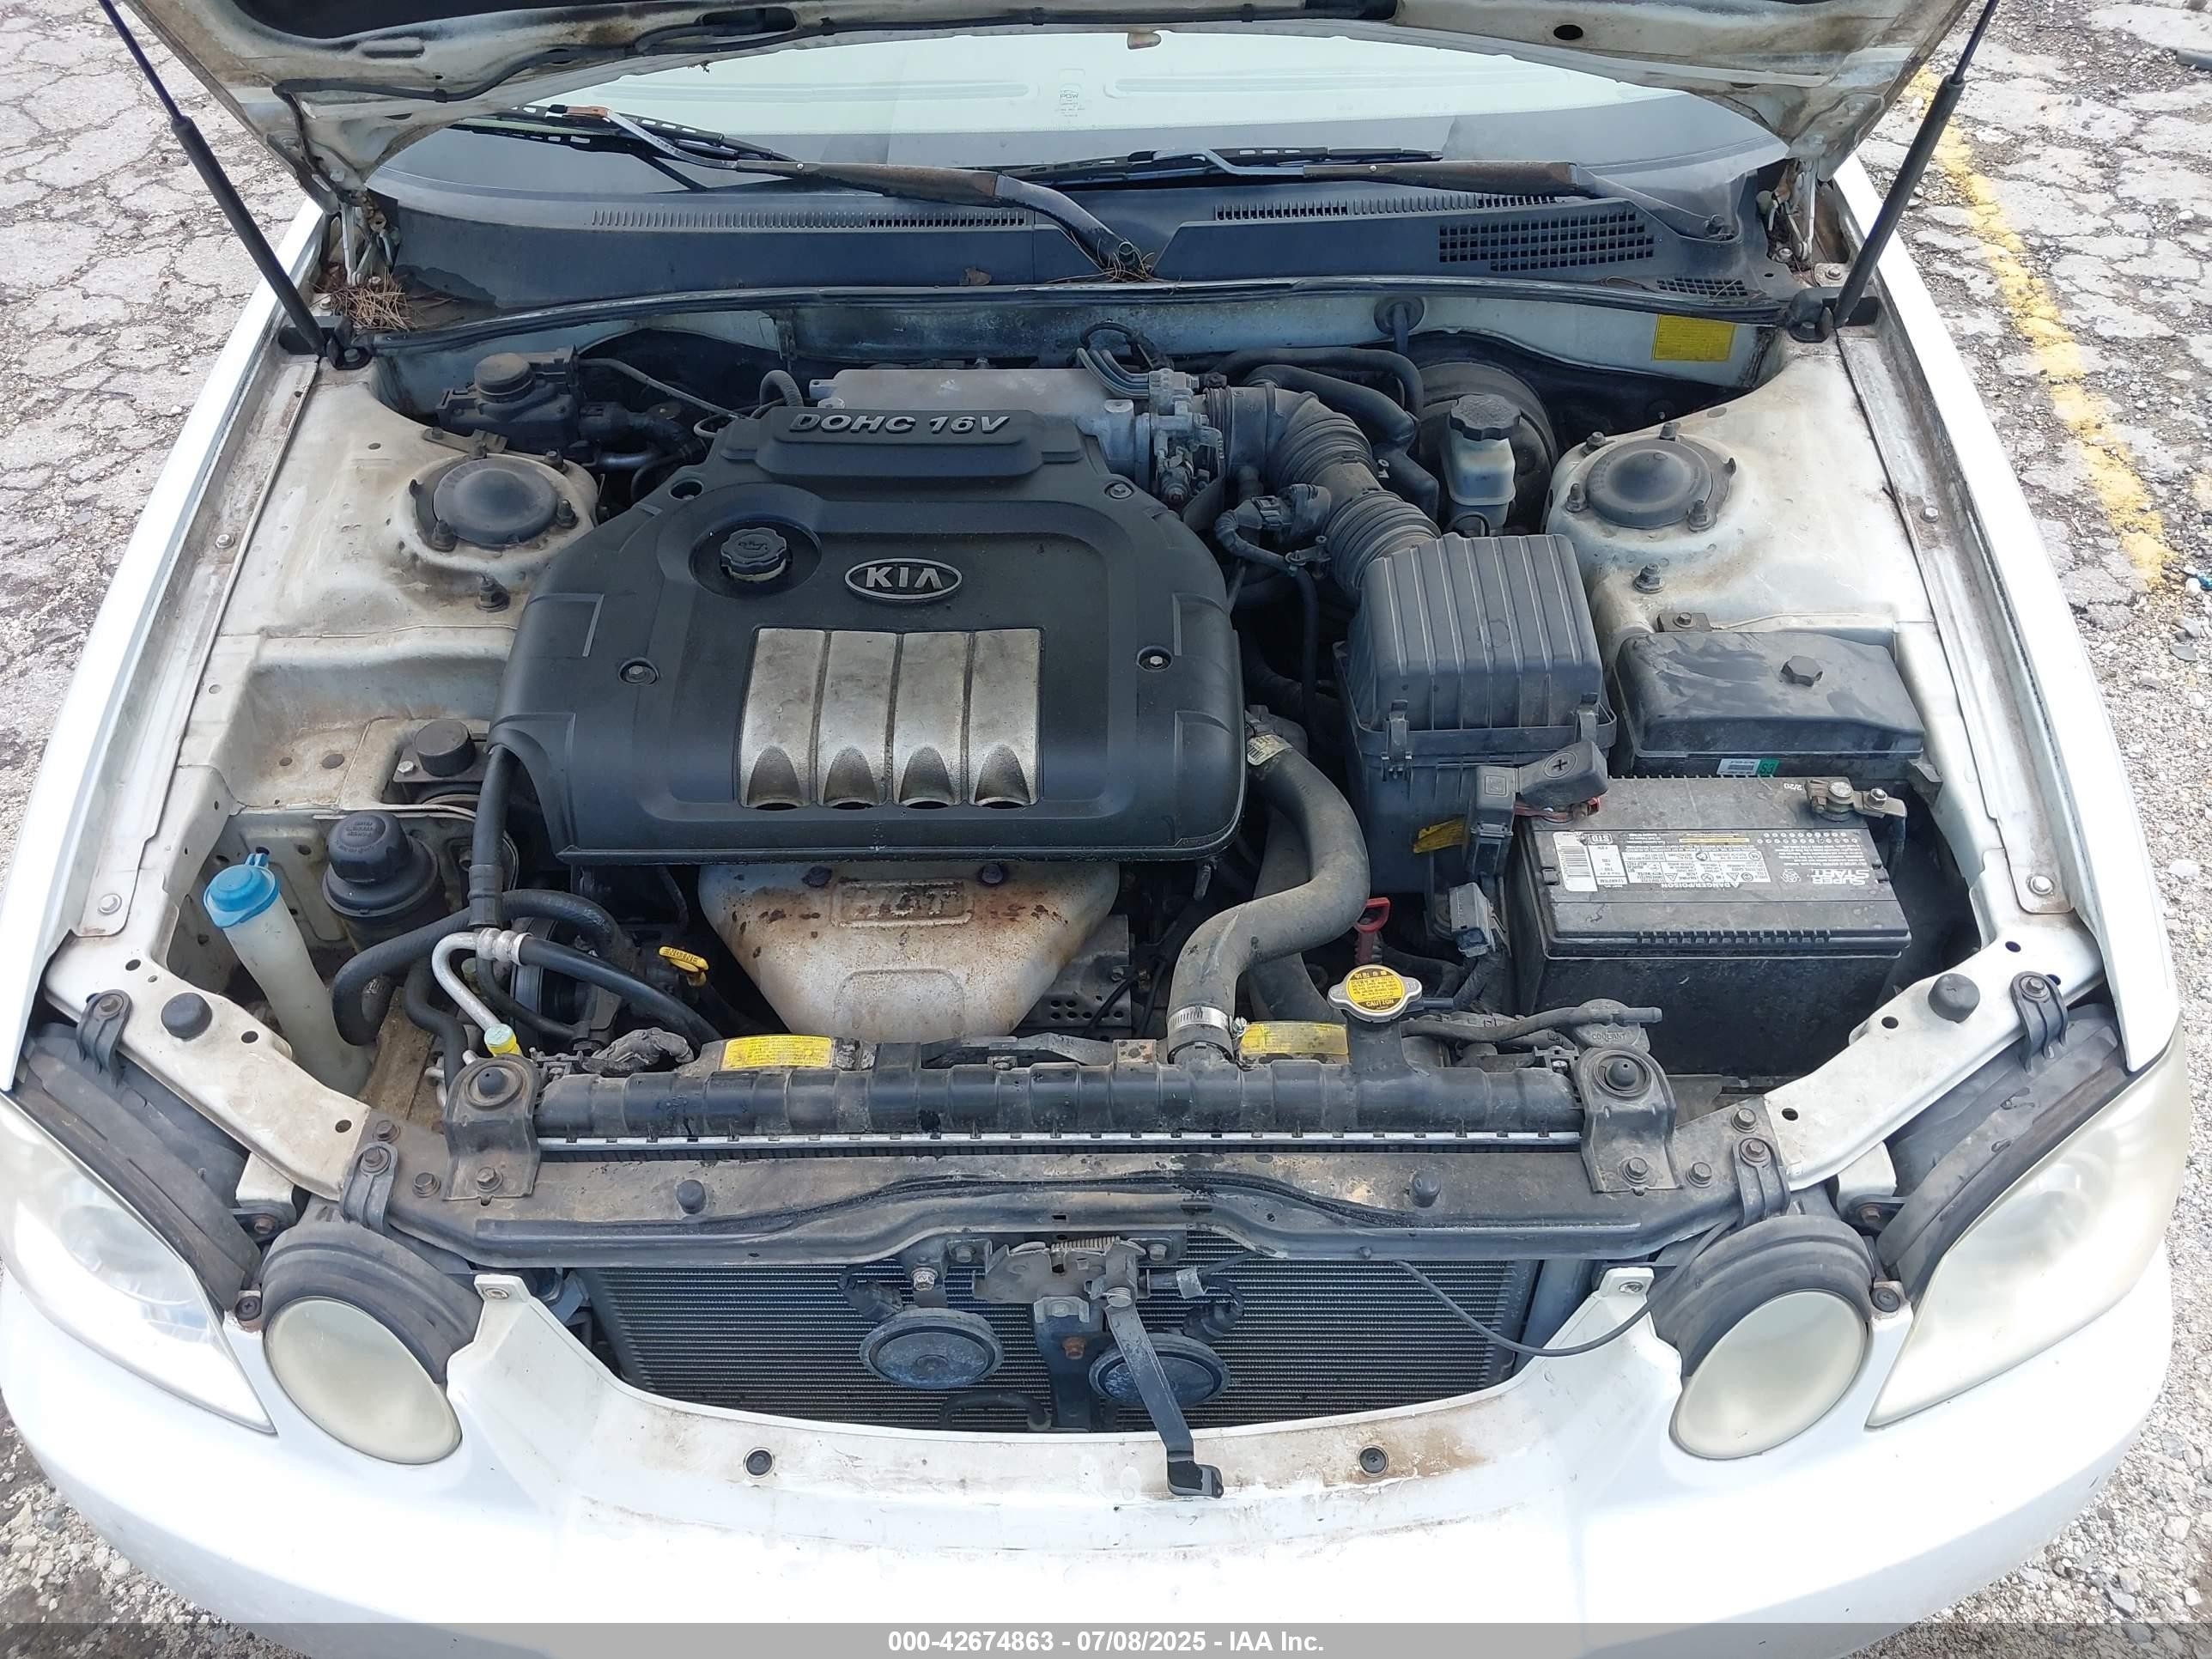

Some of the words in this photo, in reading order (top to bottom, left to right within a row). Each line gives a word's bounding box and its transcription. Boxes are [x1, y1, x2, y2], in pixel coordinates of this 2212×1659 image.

[788, 414, 916, 434] DOHC
[928, 416, 1010, 434] 16V
[866, 566, 944, 590] KIA
[1811, 868, 1870, 878] START
[1812, 877, 1866, 885] SUPER
[1365, 999, 1395, 1007] CAUTION
[1591, 1031, 1627, 1041] COOLANT
